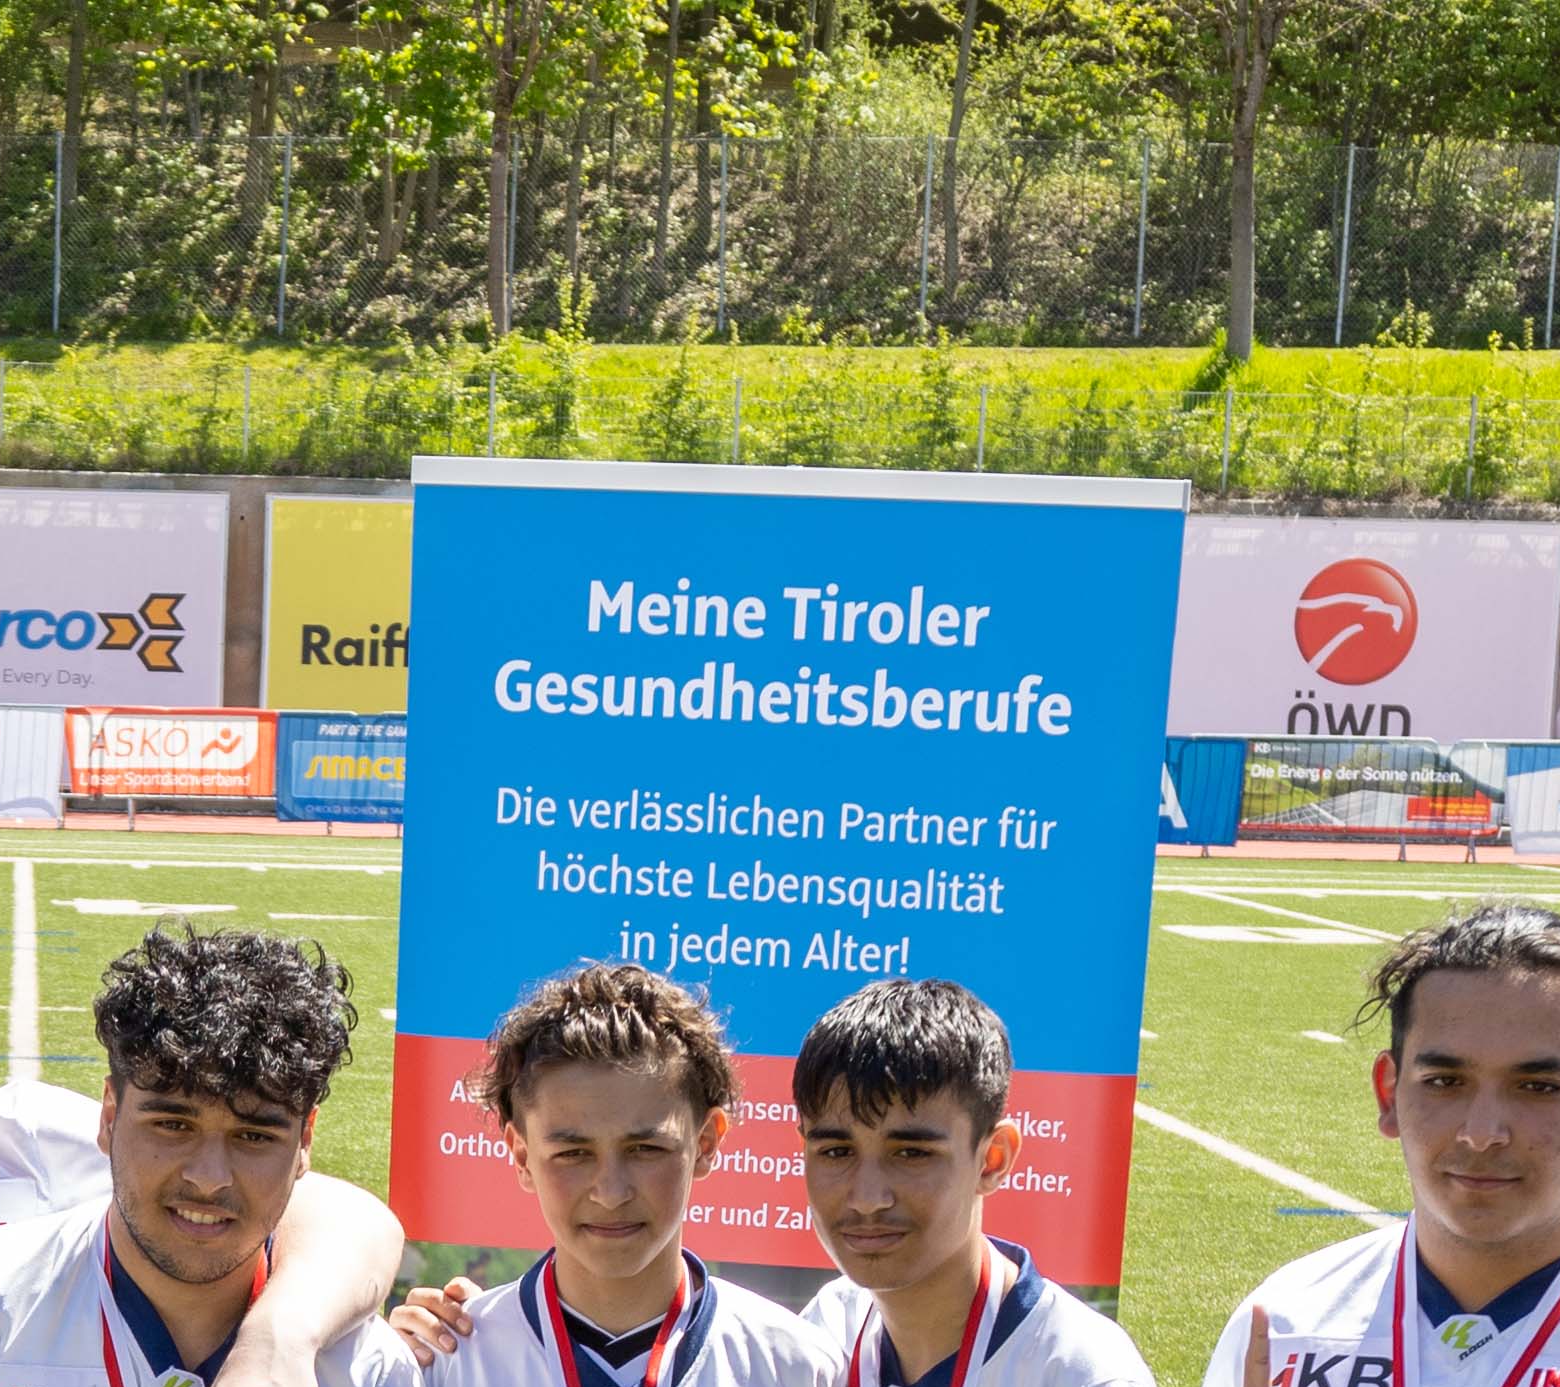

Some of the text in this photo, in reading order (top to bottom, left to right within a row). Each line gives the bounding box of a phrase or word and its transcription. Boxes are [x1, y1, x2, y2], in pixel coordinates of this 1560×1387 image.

[587, 578, 990, 648] Meine Tiroler
[2, 666, 51, 688] Every
[57, 667, 95, 688] Day.
[493, 658, 1073, 736] Gesundheitsberufe
[91, 718, 190, 759] ASKÖ
[318, 723, 384, 737] PART OF THE
[79, 770, 252, 789] Unser Sportdachverband
[1250, 763, 1464, 784] Die Energie der Sonne nützen.
[496, 787, 1057, 851] Die verlässlichen Partner für
[536, 850, 1005, 920] höchste Lebensqualität
[621, 920, 910, 974] in jedem Alter!
[722, 1204, 768, 1230] und
